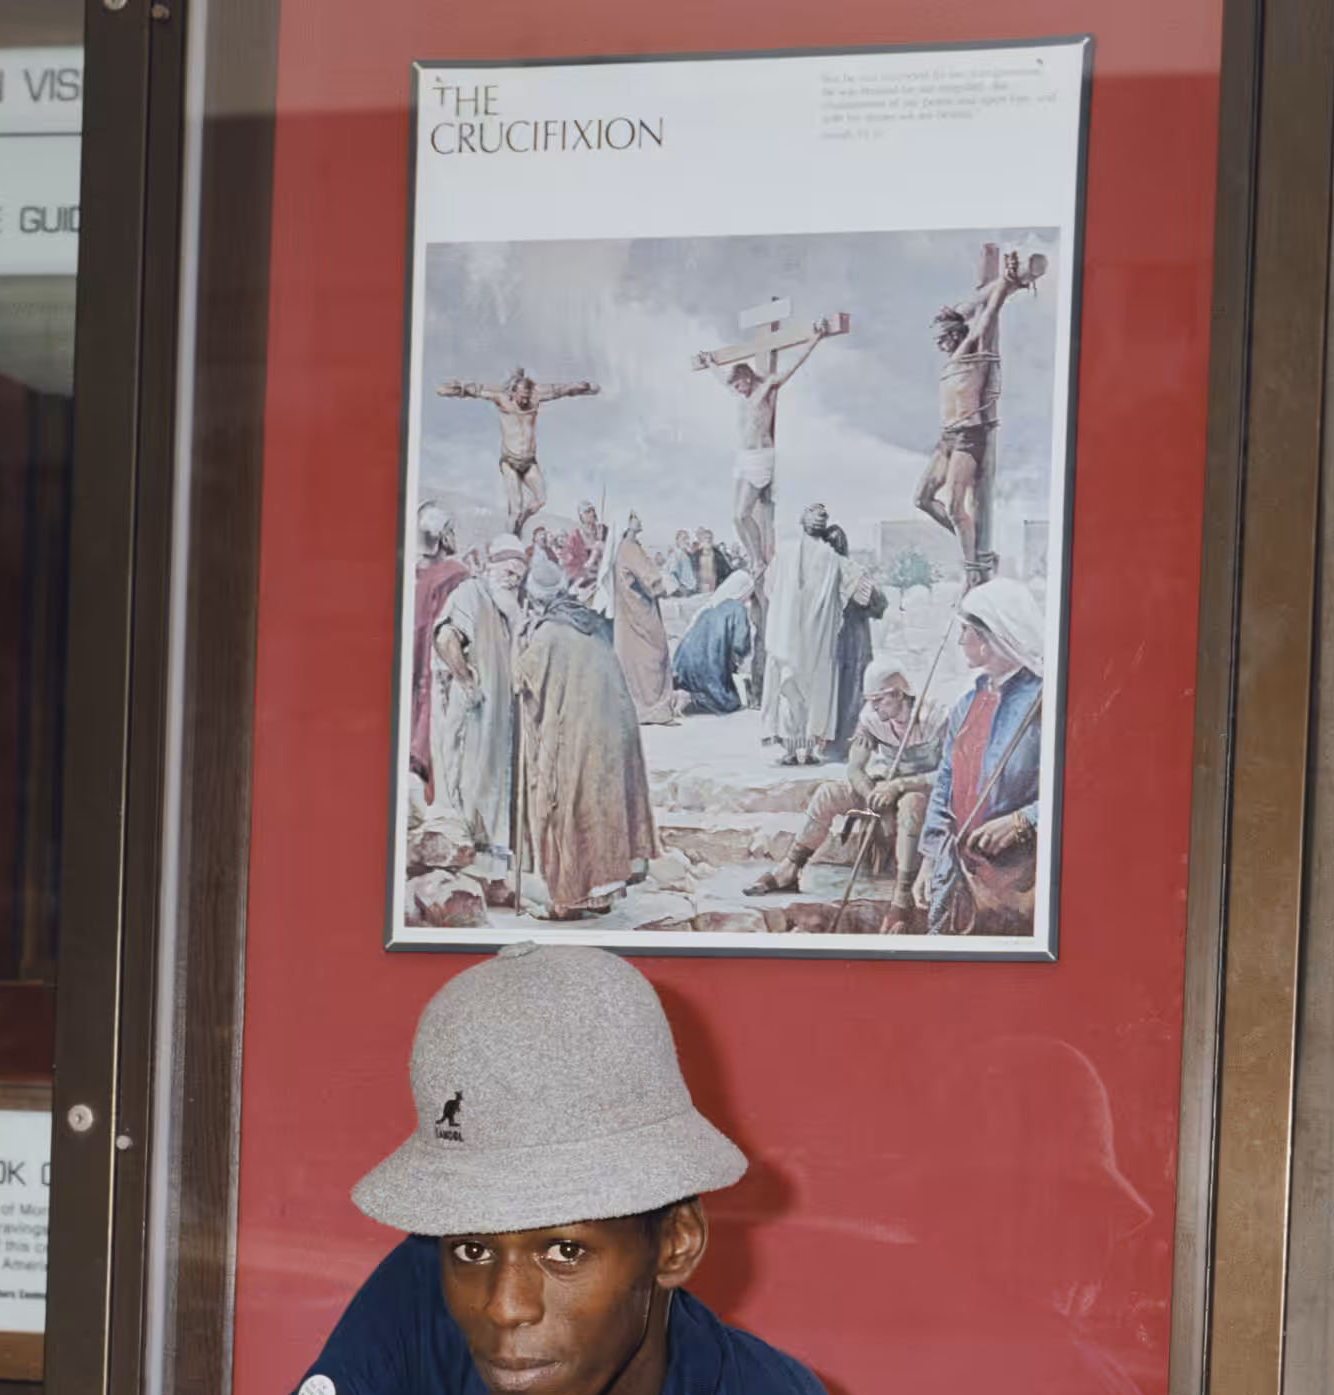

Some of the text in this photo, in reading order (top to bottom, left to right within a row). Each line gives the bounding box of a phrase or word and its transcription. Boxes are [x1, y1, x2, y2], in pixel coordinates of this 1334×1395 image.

[23, 68, 80, 102] VIS
[432, 84, 500, 117] THE
[430, 117, 664, 155] CRUCIFIXION
[0, 1201, 15, 1215] of
